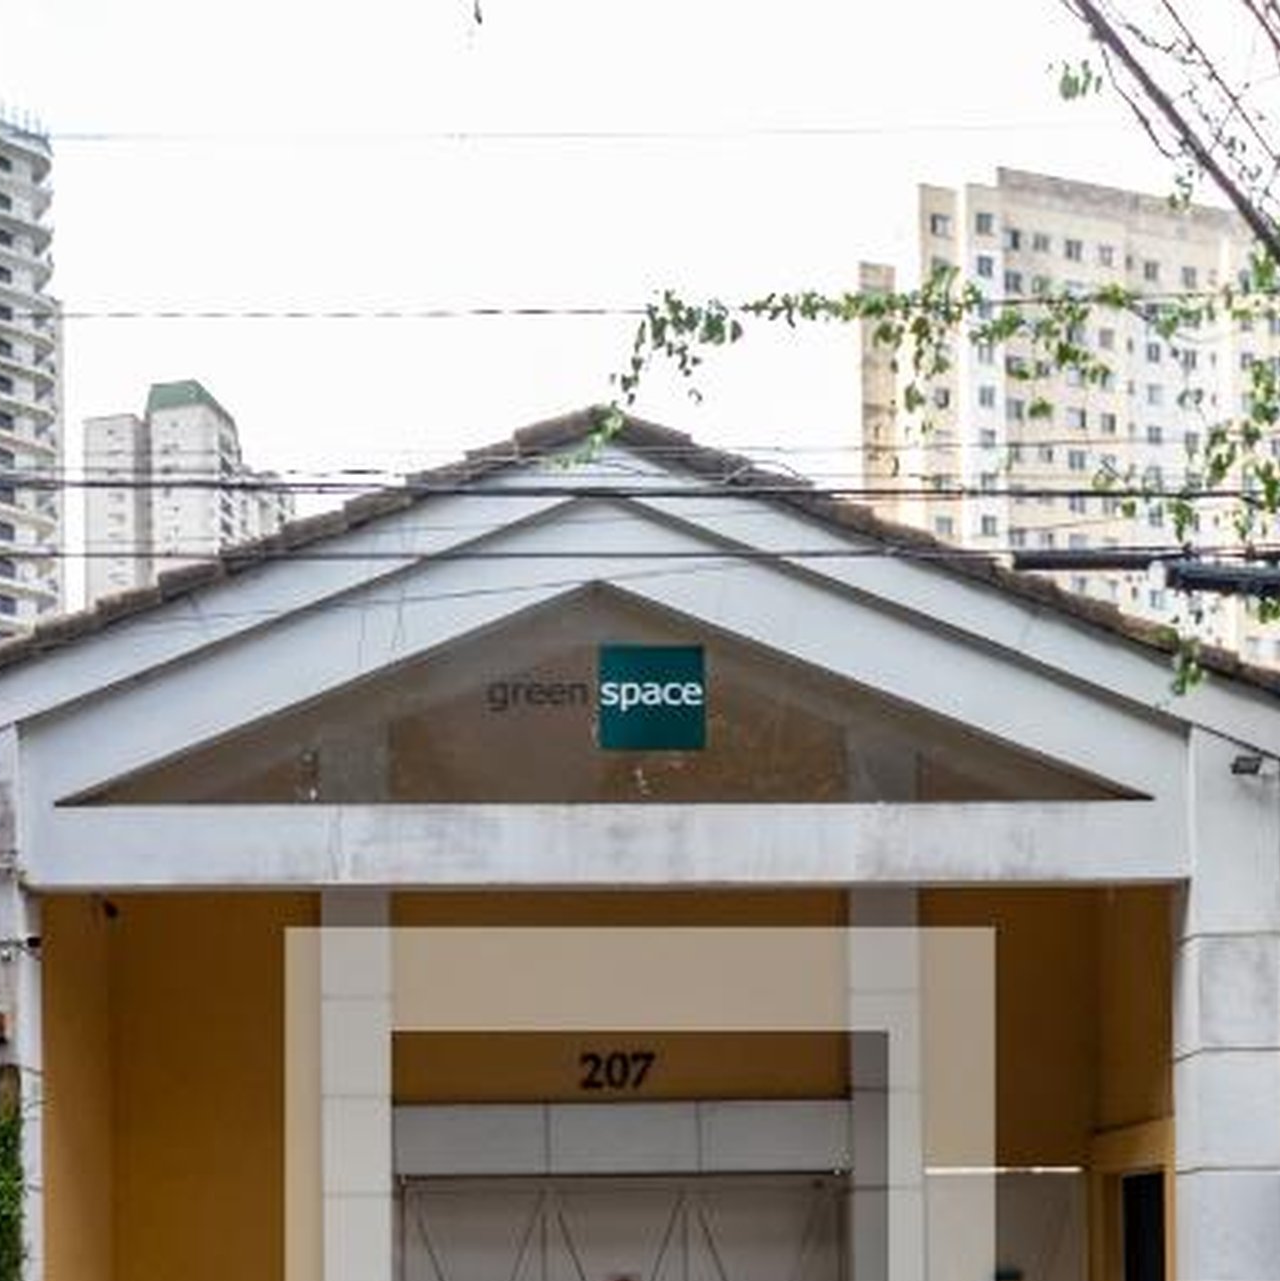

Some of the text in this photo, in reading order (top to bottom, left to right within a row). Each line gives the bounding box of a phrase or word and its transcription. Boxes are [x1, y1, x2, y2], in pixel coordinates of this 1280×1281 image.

[487, 679, 703, 711] green space
[580, 1051, 655, 1090] 207
